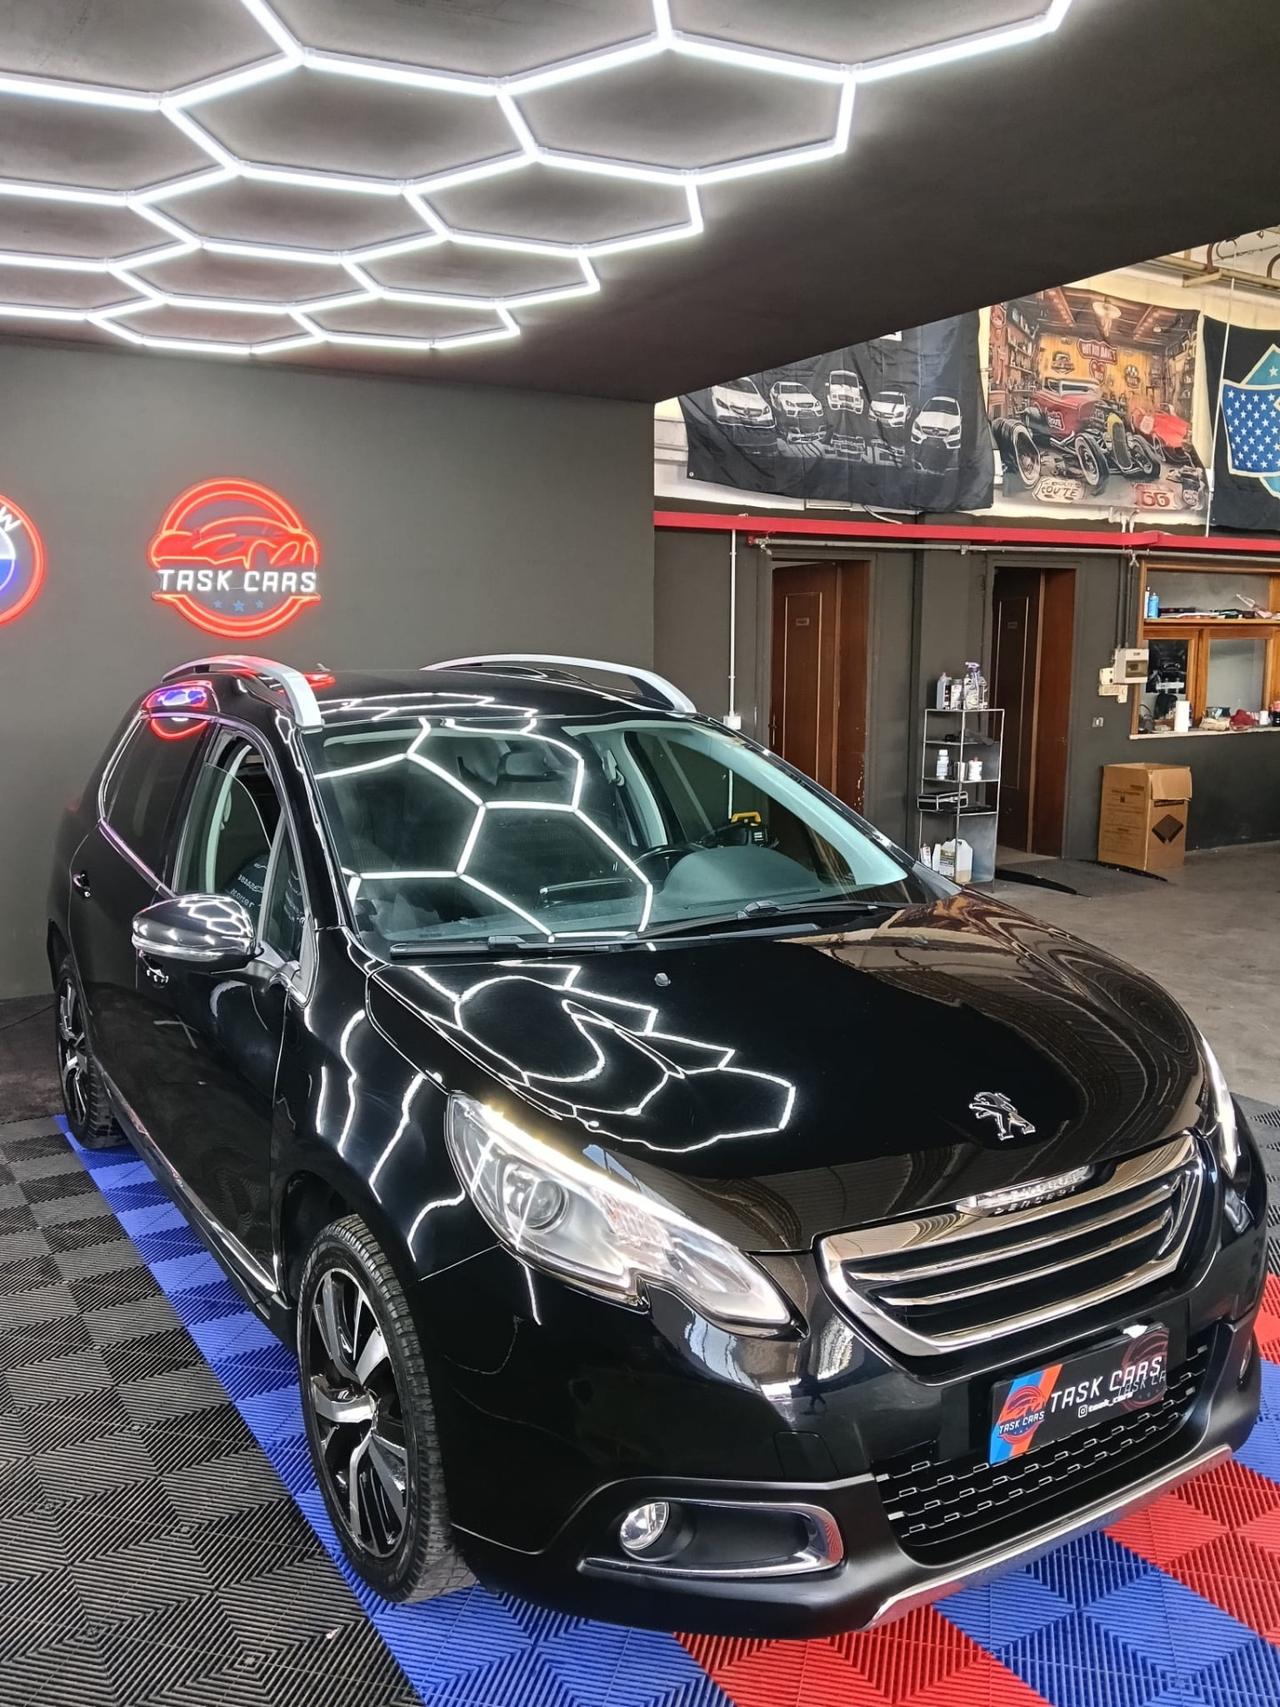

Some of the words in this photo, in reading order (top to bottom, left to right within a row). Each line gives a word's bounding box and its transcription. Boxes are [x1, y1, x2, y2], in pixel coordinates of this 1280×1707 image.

[157, 569, 233, 592] TASK
[243, 570, 317, 593] CARS
[1051, 1376, 1104, 1413] TASK
[1109, 1356, 1162, 1392] CARS
[999, 1420, 1020, 1435] TASK
[1022, 1410, 1045, 1426] CARS
